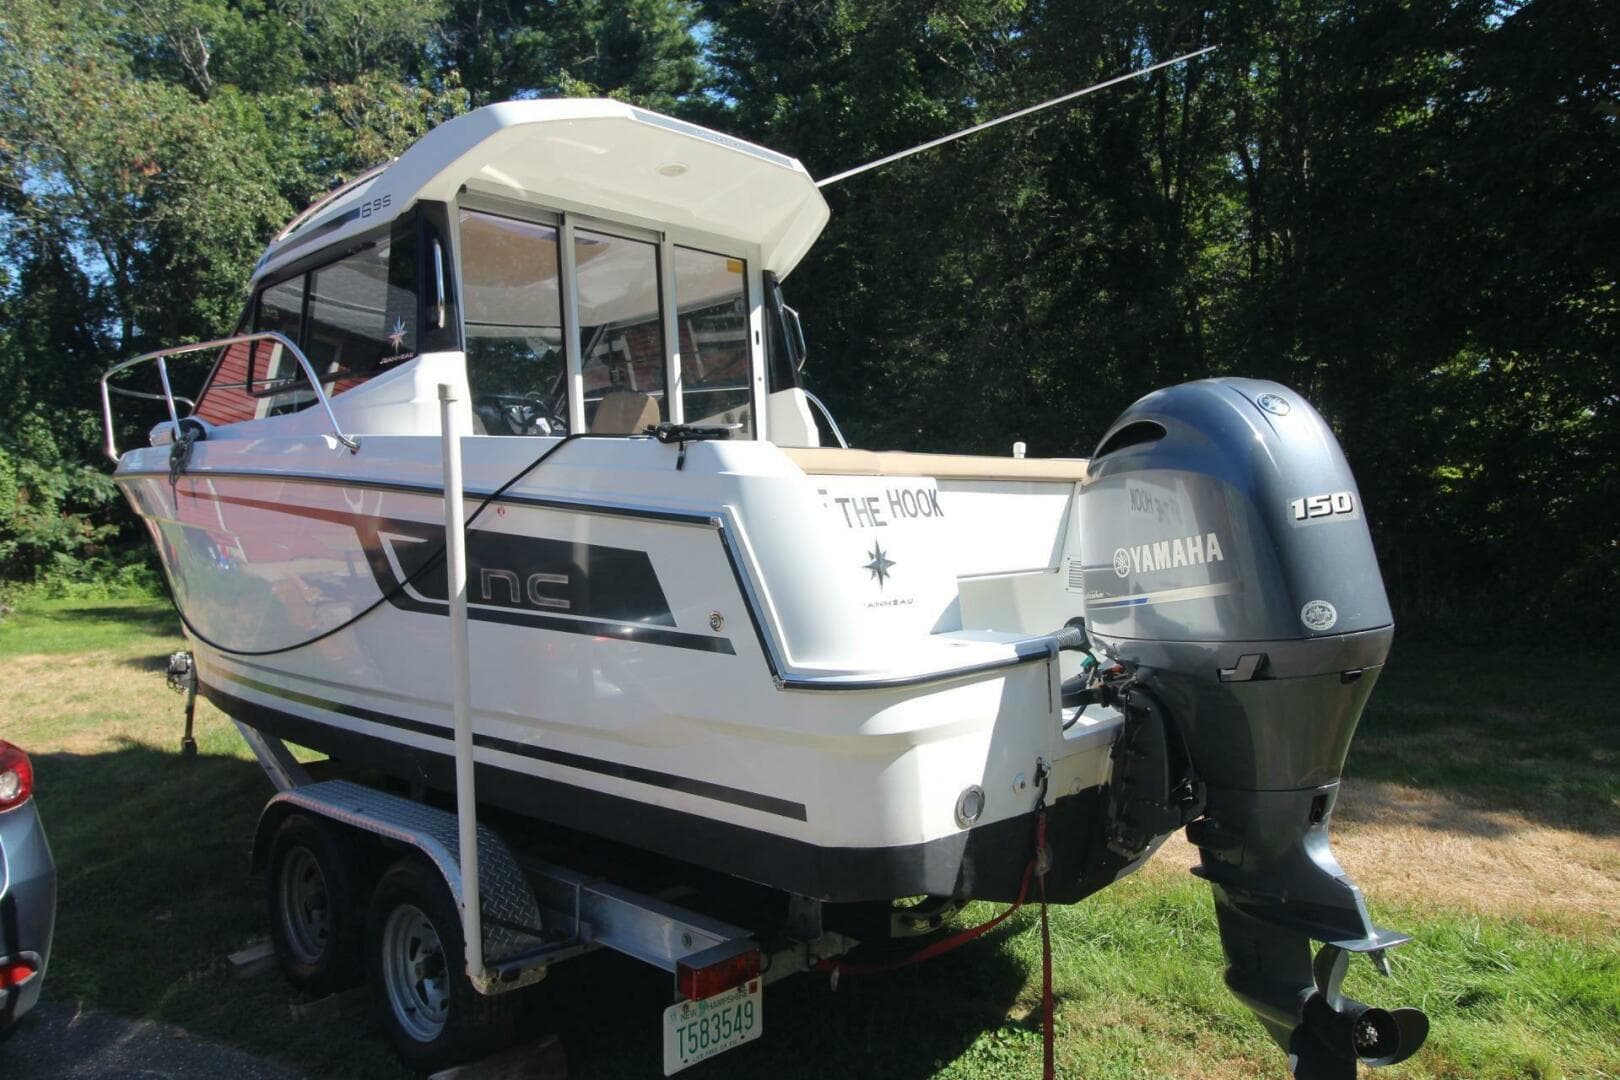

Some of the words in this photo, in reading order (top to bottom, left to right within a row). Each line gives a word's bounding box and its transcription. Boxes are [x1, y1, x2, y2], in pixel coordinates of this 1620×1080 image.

[834, 496, 888, 529] THE
[886, 488, 945, 519] HOOK
[1291, 491, 1353, 521] 150
[1129, 532, 1224, 573] YAMAHA
[676, 1000, 754, 1059] T583549
